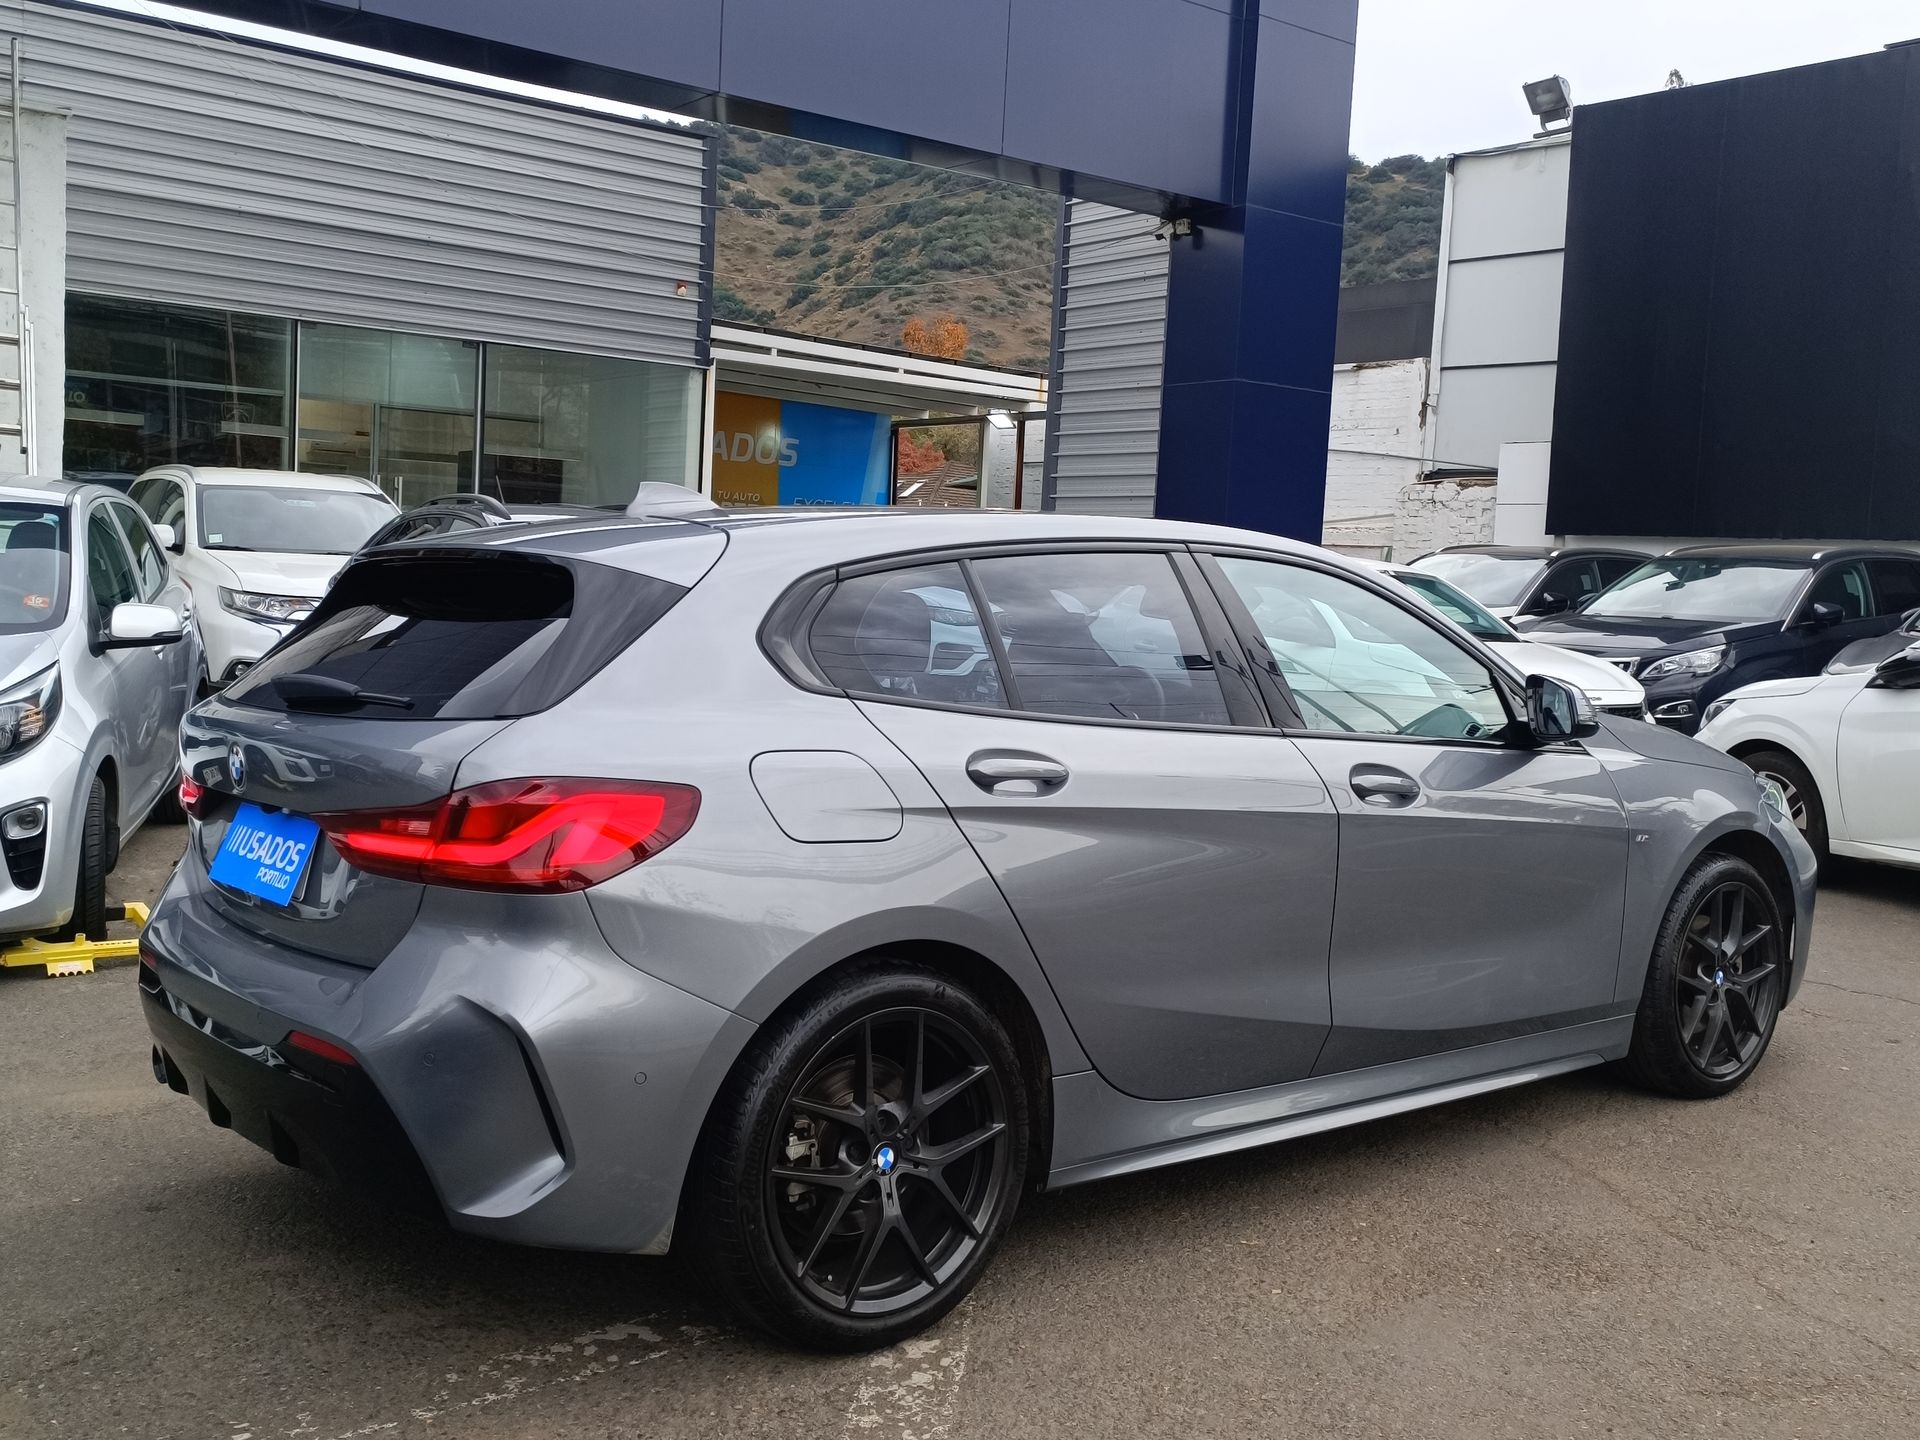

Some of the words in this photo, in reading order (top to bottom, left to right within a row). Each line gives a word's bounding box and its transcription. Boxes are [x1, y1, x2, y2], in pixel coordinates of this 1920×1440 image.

[717, 490, 731, 500] TU
[732, 491, 761, 502] AUTO
[238, 828, 306, 873] USADOS
[255, 866, 291, 890] PORTILLO
